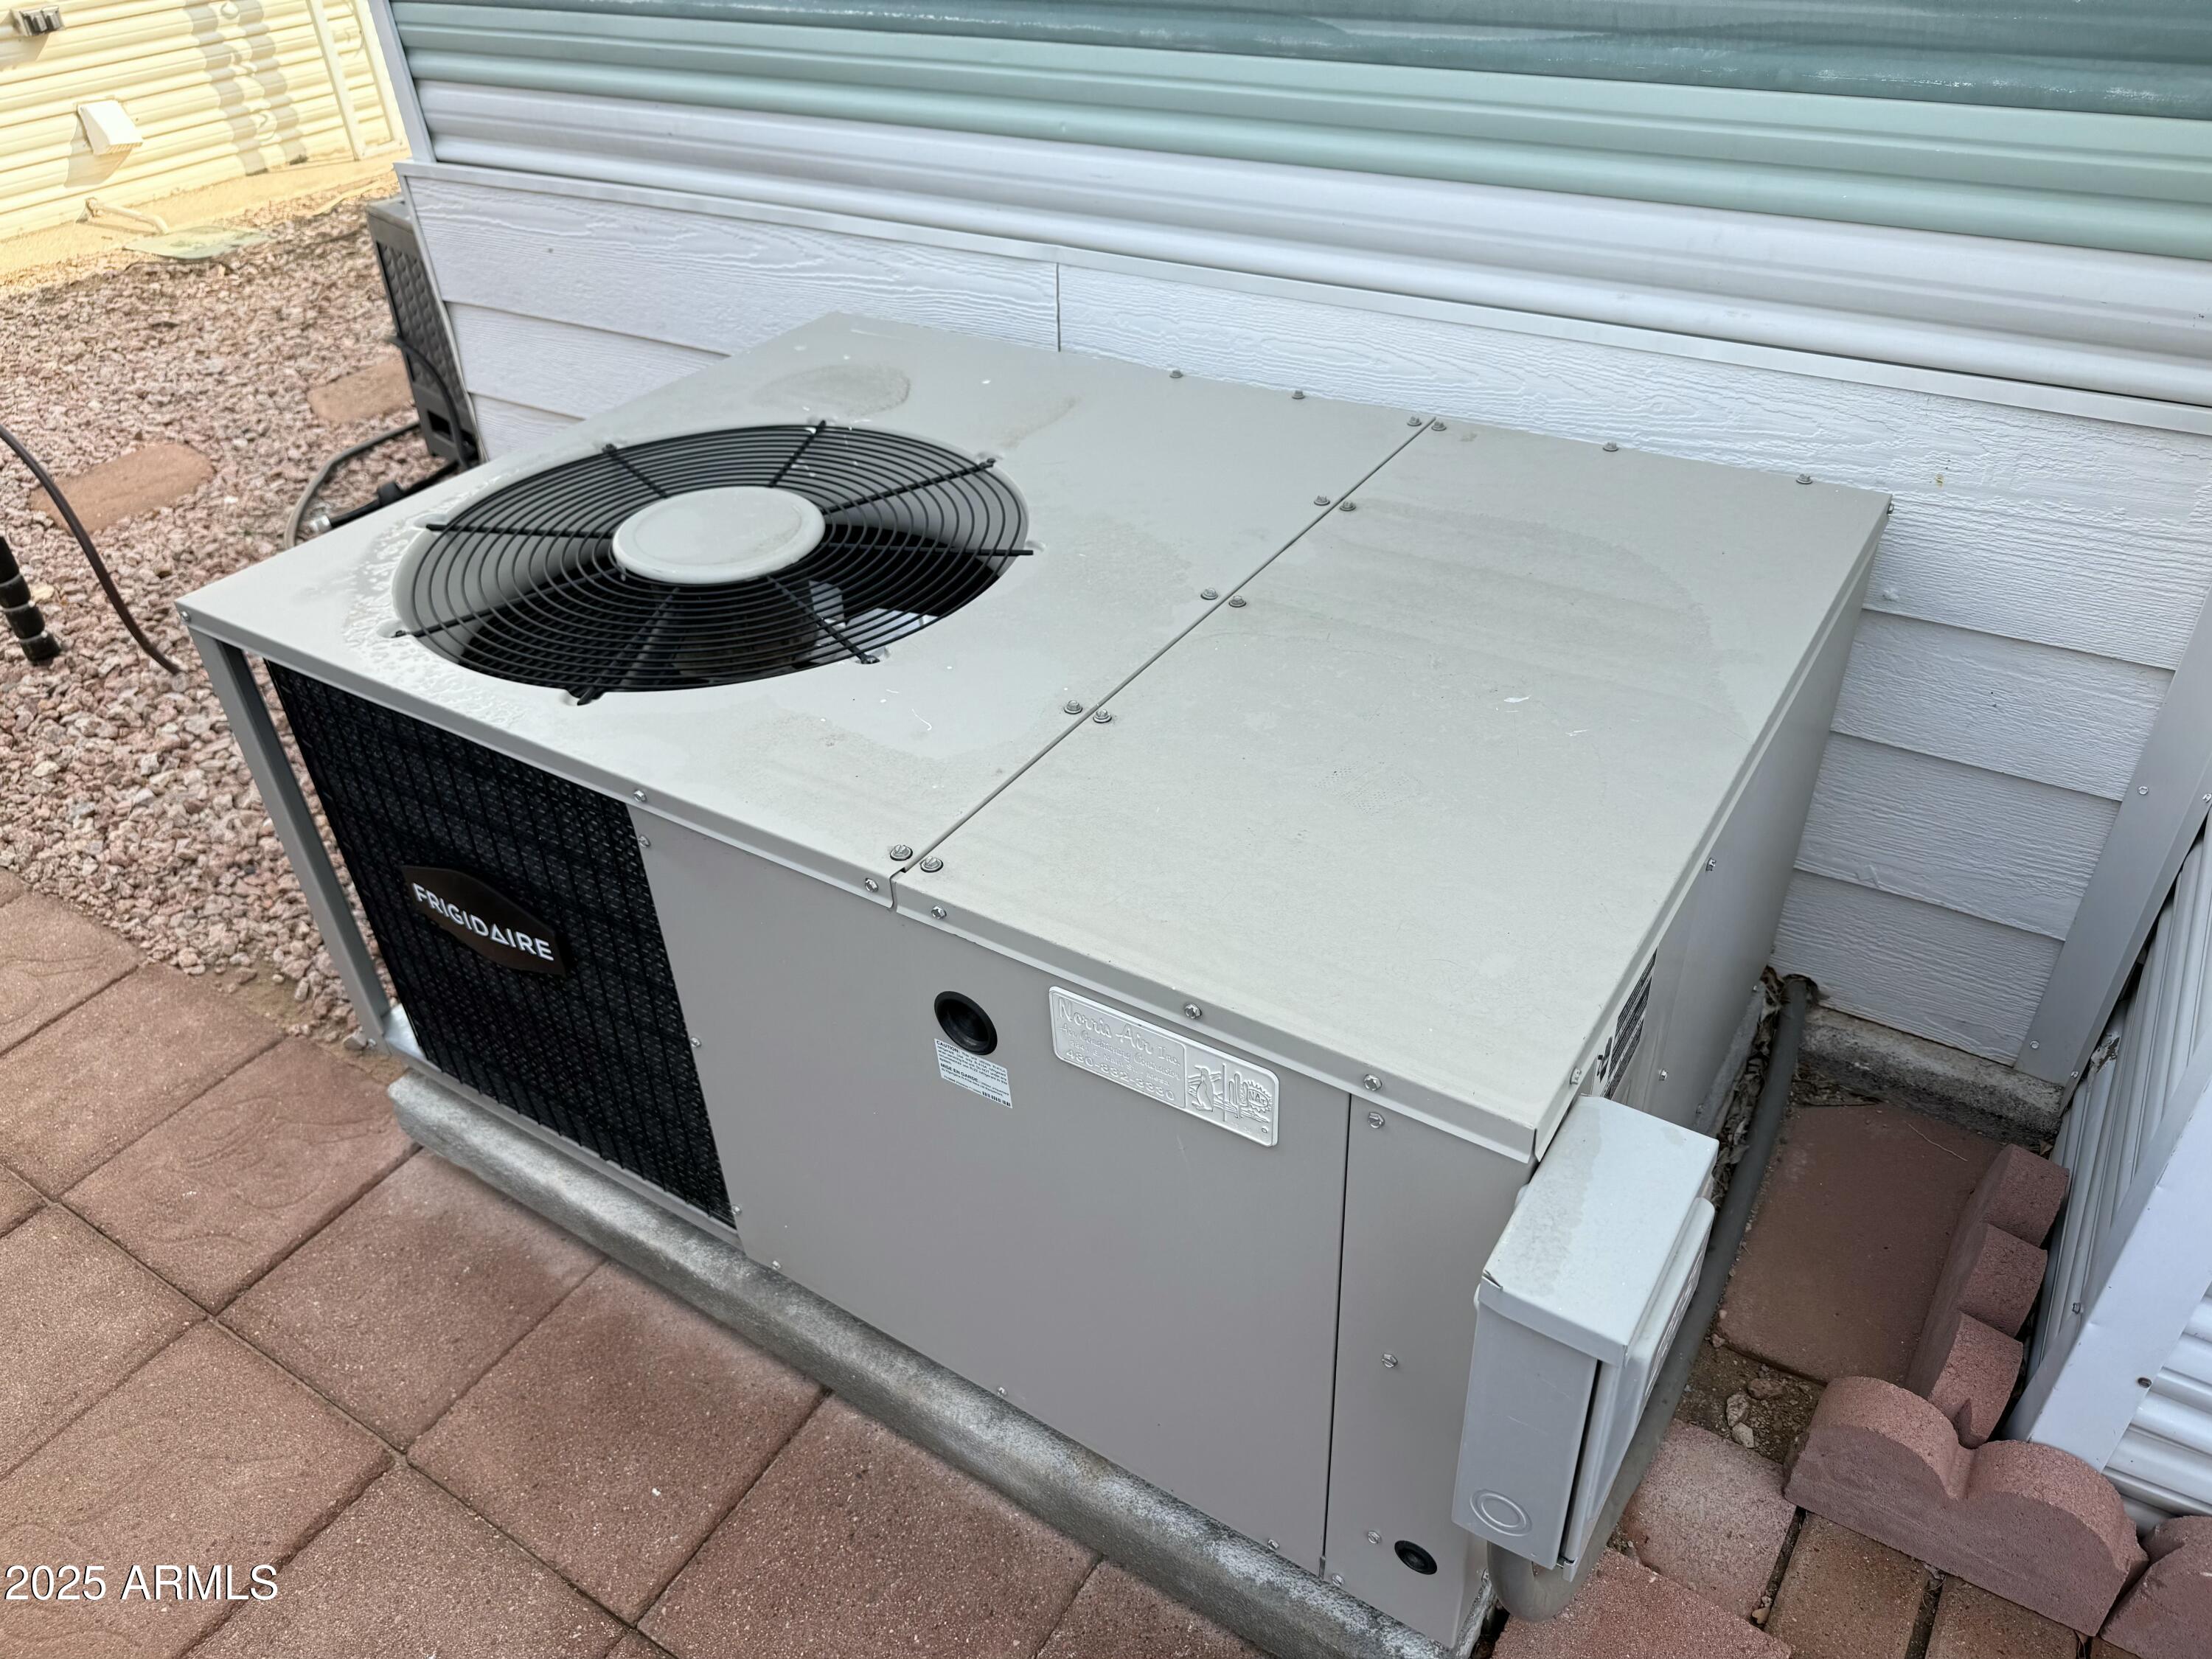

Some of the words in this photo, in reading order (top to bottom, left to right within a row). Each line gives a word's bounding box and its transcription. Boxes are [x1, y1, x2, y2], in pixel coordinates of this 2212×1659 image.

[411, 883, 554, 961] FRIGIDAIRE
[1059, 997, 1112, 1039] Norris
[1115, 1023, 1152, 1054] Air
[1158, 1046, 1180, 1066] Inc.
[1066, 1048, 1175, 1101] 480-832-3330
